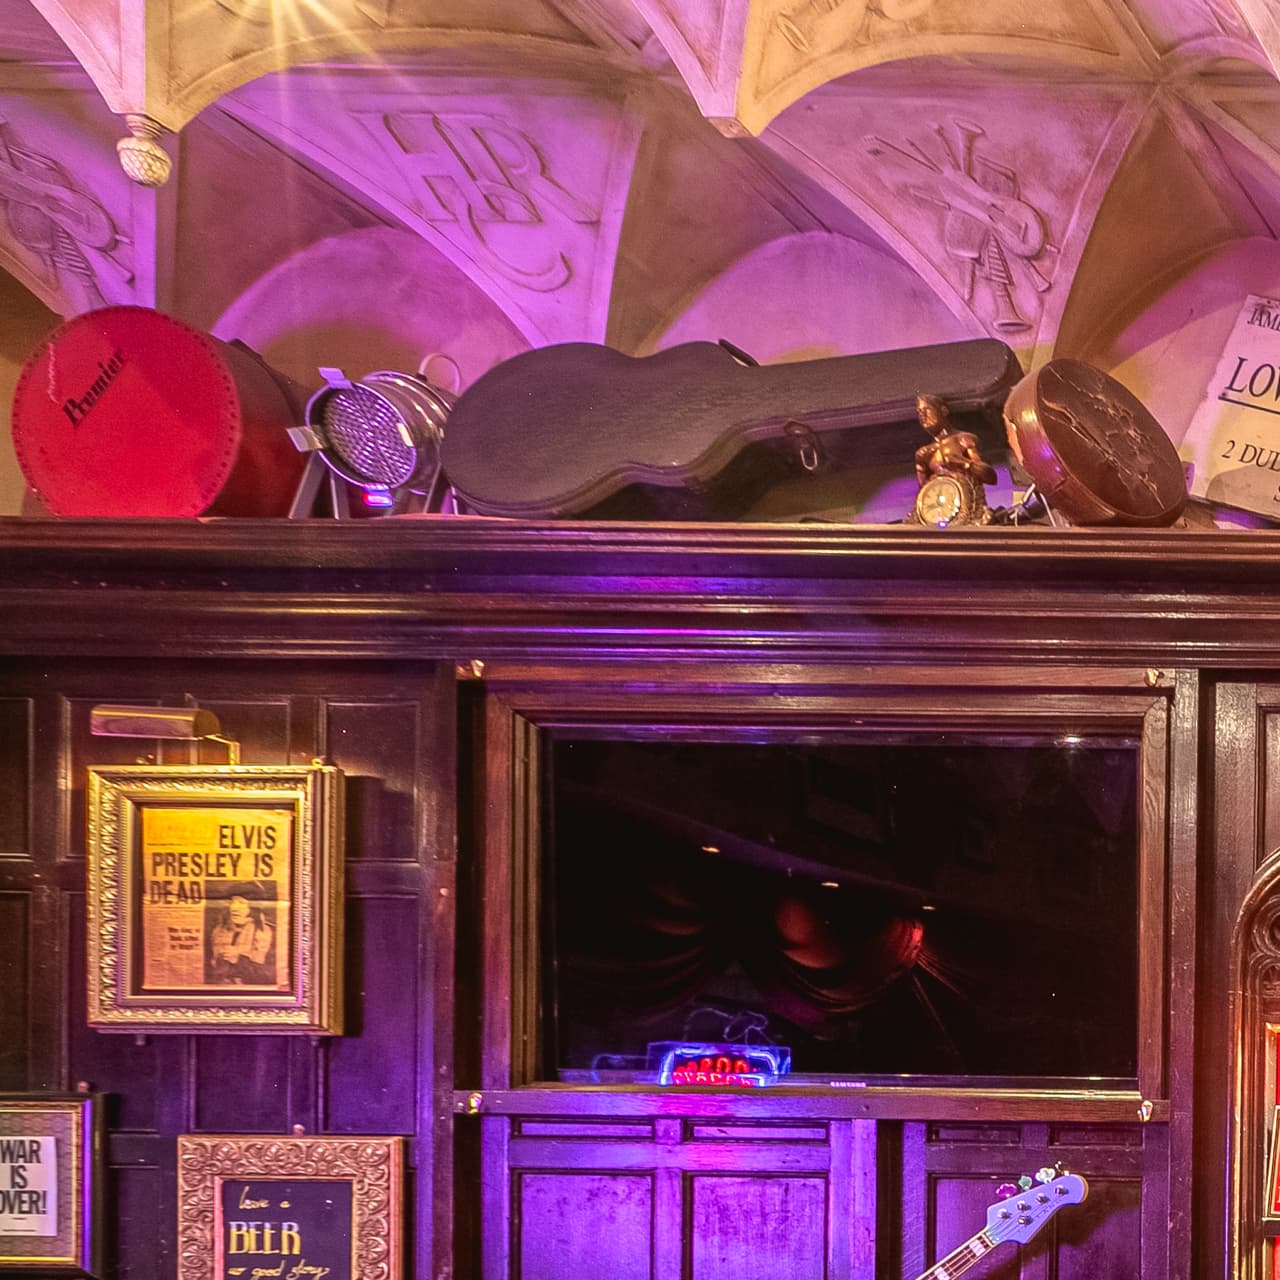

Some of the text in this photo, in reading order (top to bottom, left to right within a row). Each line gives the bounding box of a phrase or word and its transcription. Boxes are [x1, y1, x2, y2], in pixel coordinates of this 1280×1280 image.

[63, 348, 126, 430] Premier
[1222, 440, 1236, 459] 2
[219, 825, 276, 849] ELVIS
[152, 852, 274, 878] PRESLEY IS
[150, 880, 201, 905] DEAD
[0, 1139, 41, 1164] WAR
[10, 1165, 28, 1189] IS
[228, 1221, 301, 1256] BEER
